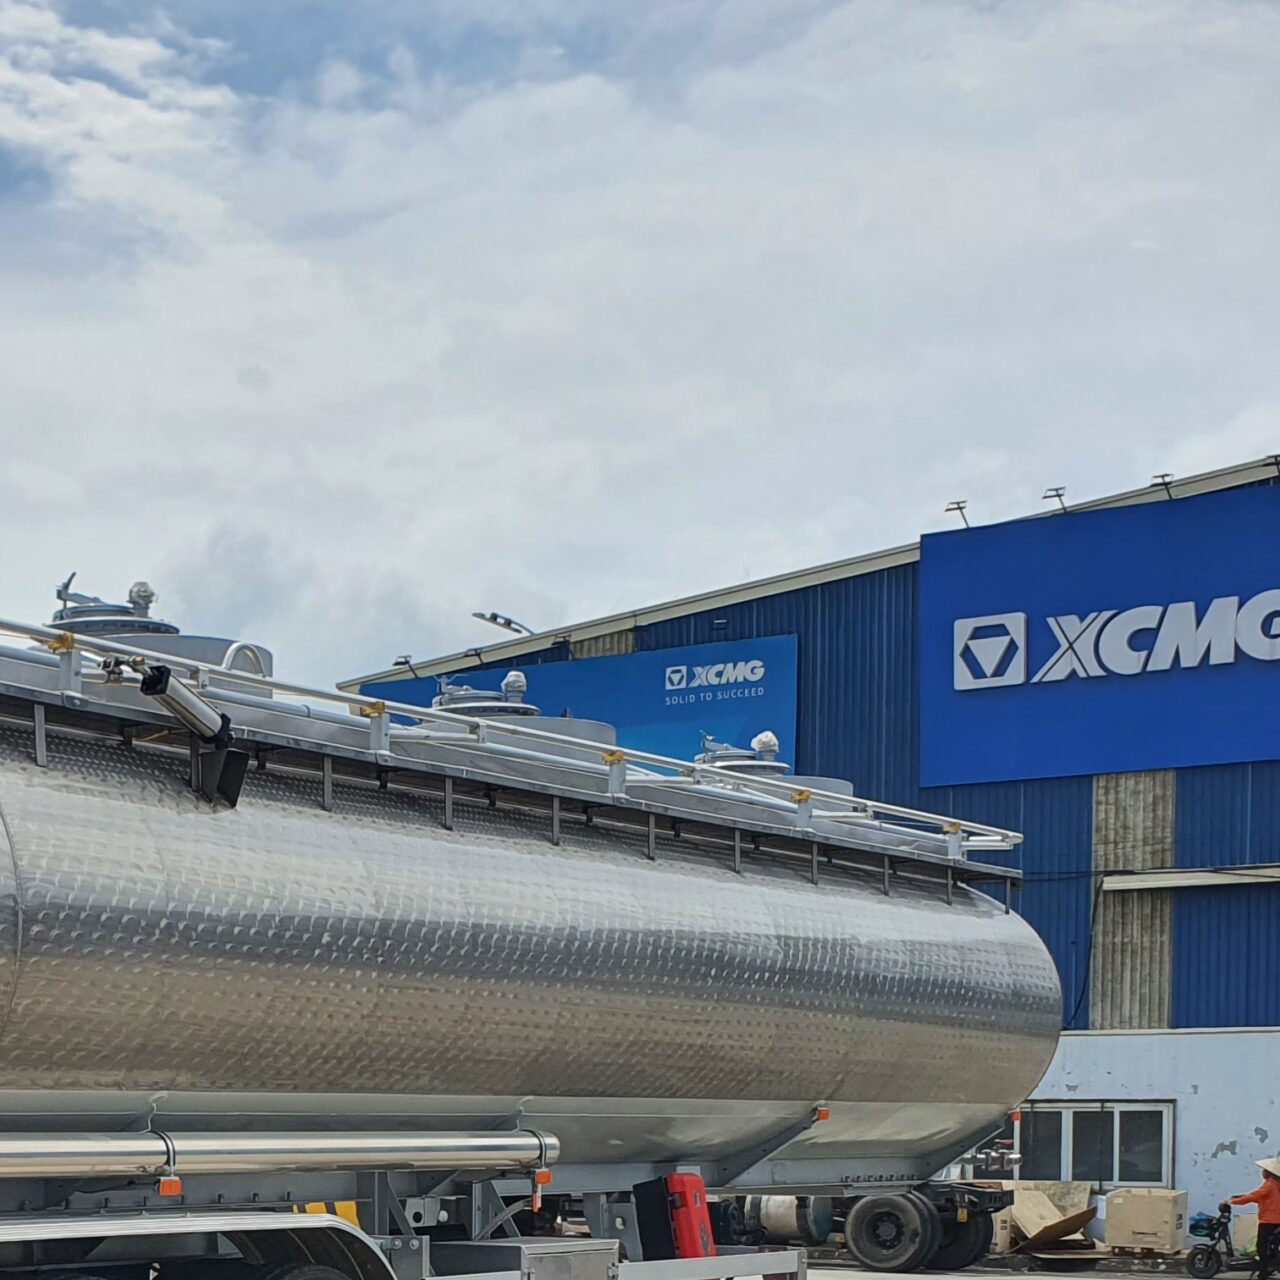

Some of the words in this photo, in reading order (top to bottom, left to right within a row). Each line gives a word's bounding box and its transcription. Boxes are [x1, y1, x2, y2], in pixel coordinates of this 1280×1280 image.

[1030, 588, 1280, 684] XCMG
[688, 659, 765, 688] XCMG
[665, 694, 696, 706] SOLID
[700, 692, 713, 701] TO
[717, 687, 764, 700] SUCCEED
